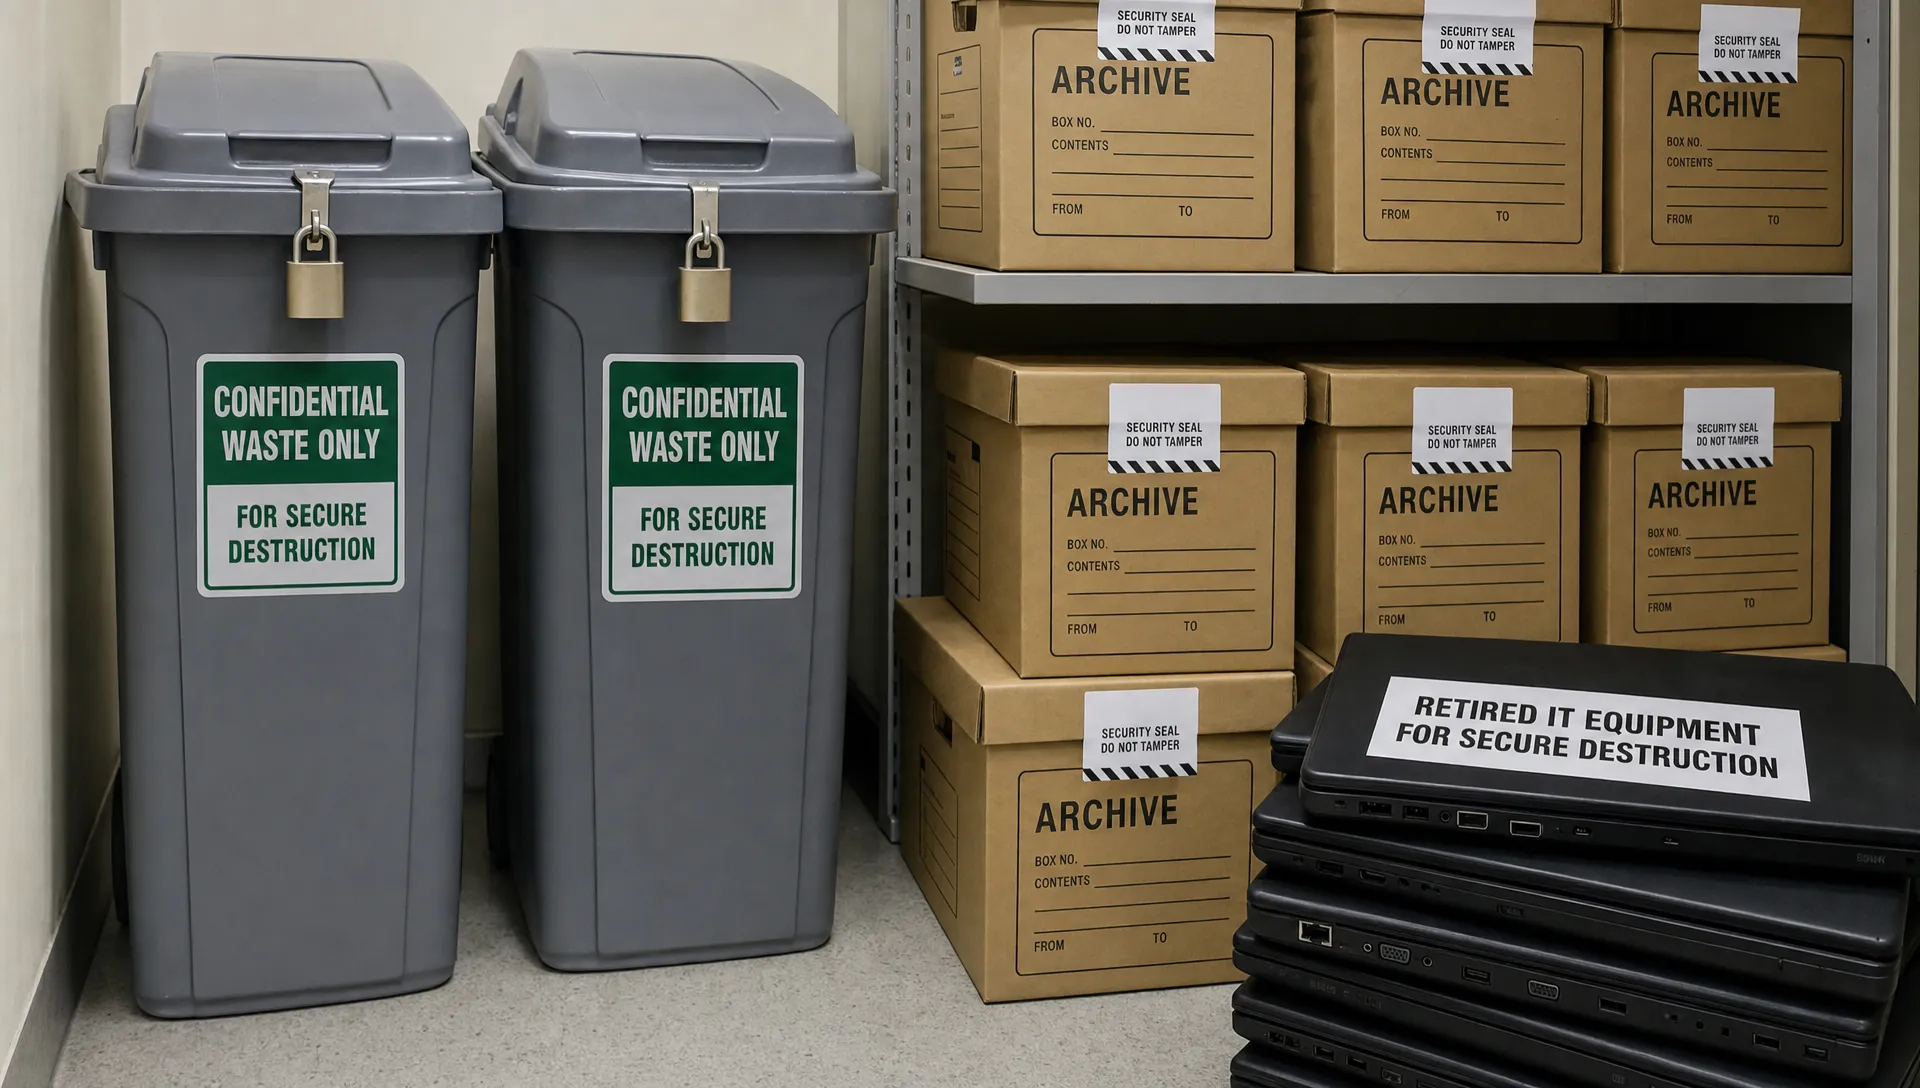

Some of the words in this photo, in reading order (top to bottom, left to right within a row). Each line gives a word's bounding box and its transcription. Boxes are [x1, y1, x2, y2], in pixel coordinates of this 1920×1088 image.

[1118, 10, 1167, 21] SECURITY
[1171, 12, 1196, 22] SEAL
[1118, 24, 1130, 34] DO
[1135, 25, 1154, 35] NOT
[1157, 26, 1196, 36] TAMPER
[1441, 26, 1488, 36] SECURITY
[1492, 28, 1515, 37] SEAL
[1441, 39, 1453, 49] DO
[1457, 40, 1475, 50] NOT
[1478, 41, 1514, 51] TAMPER
[1715, 36, 1757, 45] SECURITY
[1760, 37, 1780, 46] SEAL
[1715, 49, 1725, 58] DO
[1729, 49, 1745, 58] NOT
[1748, 49, 1780, 59] TAMPER
[1052, 66, 1190, 95] ARCHIVE
[1381, 78, 1509, 107] ARCHIVE
[1667, 91, 1780, 118] ARCHIVE
[1052, 117, 1073, 127] BOX
[1077, 117, 1094, 128] NO.
[1381, 126, 1400, 136] BOX
[1404, 127, 1420, 137] NO.
[1052, 139, 1108, 151] CONTENTS
[1667, 137, 1684, 147] BOX
[1687, 137, 1702, 147] NO.
[1381, 148, 1432, 159] CONTENTS
[1667, 157, 1712, 167] CONTENTS
[1053, 204, 1082, 214] FROM
[1179, 206, 1192, 216] TO
[1382, 209, 1409, 219] FROM
[1496, 211, 1509, 221] TO
[1667, 214, 1692, 224] FROM
[1768, 215, 1779, 225] TO
[215, 386, 388, 417] CONFIDENTIAL
[623, 386, 787, 418] CONFIDENTIAL
[1127, 422, 1175, 432] SECURITY
[1179, 422, 1202, 432] SEAL
[1429, 425, 1471, 435] SECURITY
[1475, 425, 1496, 435] SEAL
[1697, 423, 1736, 433] SECURITY
[1739, 423, 1758, 432] SEAL
[222, 430, 308, 461] WASTE
[319, 429, 380, 460] ONLY
[629, 431, 711, 462] WASTE
[721, 431, 779, 462] ONLY
[1127, 437, 1139, 446] DO
[1143, 436, 1162, 446] NOT
[1165, 436, 1202, 446] TAMPER
[1428, 439, 1440, 448] DO
[1443, 439, 1460, 448] NOT
[1463, 438, 1496, 448] TAMPER
[1697, 437, 1707, 446] DO
[1710, 436, 1726, 446] NOT
[1728, 436, 1758, 445] TAMPER
[1379, 485, 1498, 514] ARCHIVE
[1648, 480, 1756, 508] ARCHIVE
[1067, 487, 1198, 517] ARCHIVE
[238, 505, 277, 528] FOR
[286, 503, 366, 527] SECURE
[641, 507, 679, 531] FOR
[688, 506, 766, 531] SECURE
[1648, 528, 1664, 538] BOX
[1667, 527, 1681, 537] NO.
[1068, 539, 1087, 549] BOX
[1091, 539, 1107, 549] NO.
[1379, 535, 1397, 545] BOX
[1400, 535, 1415, 544] NO.
[229, 537, 374, 563] DESTRUCTION
[632, 541, 773, 567] DESTRUCTION
[1648, 546, 1691, 557] CONTENTS
[1067, 561, 1120, 571] CONTENTS
[1379, 556, 1426, 566] CONTENTS
[1648, 602, 1671, 612] FROM
[1744, 598, 1755, 608] TO
[1379, 614, 1405, 625] FROM
[1484, 611, 1496, 622] TO
[1068, 623, 1096, 634] FROM
[1184, 621, 1197, 631] TO
[1415, 696, 1537, 724] RETIRED
[1548, 707, 1575, 728] IT
[1584, 710, 1761, 746] EQUIPMENT
[1102, 727, 1151, 738] SECURITY
[1155, 726, 1179, 736] SEAL
[1101, 743, 1114, 753] DO
[1119, 742, 1138, 752] NOT
[1141, 740, 1179, 751] TAMPER
[1396, 723, 1450, 746] FOR
[1459, 728, 1569, 757] SECURE
[1579, 738, 1778, 778] DESTRUCTION
[1036, 794, 1177, 833] ARCHIVE
[1035, 855, 1056, 866] BOX
[1060, 854, 1077, 865] NO.
[1035, 875, 1090, 888] CONTENTS
[1035, 940, 1064, 952] FROM
[1153, 932, 1167, 943] TO
